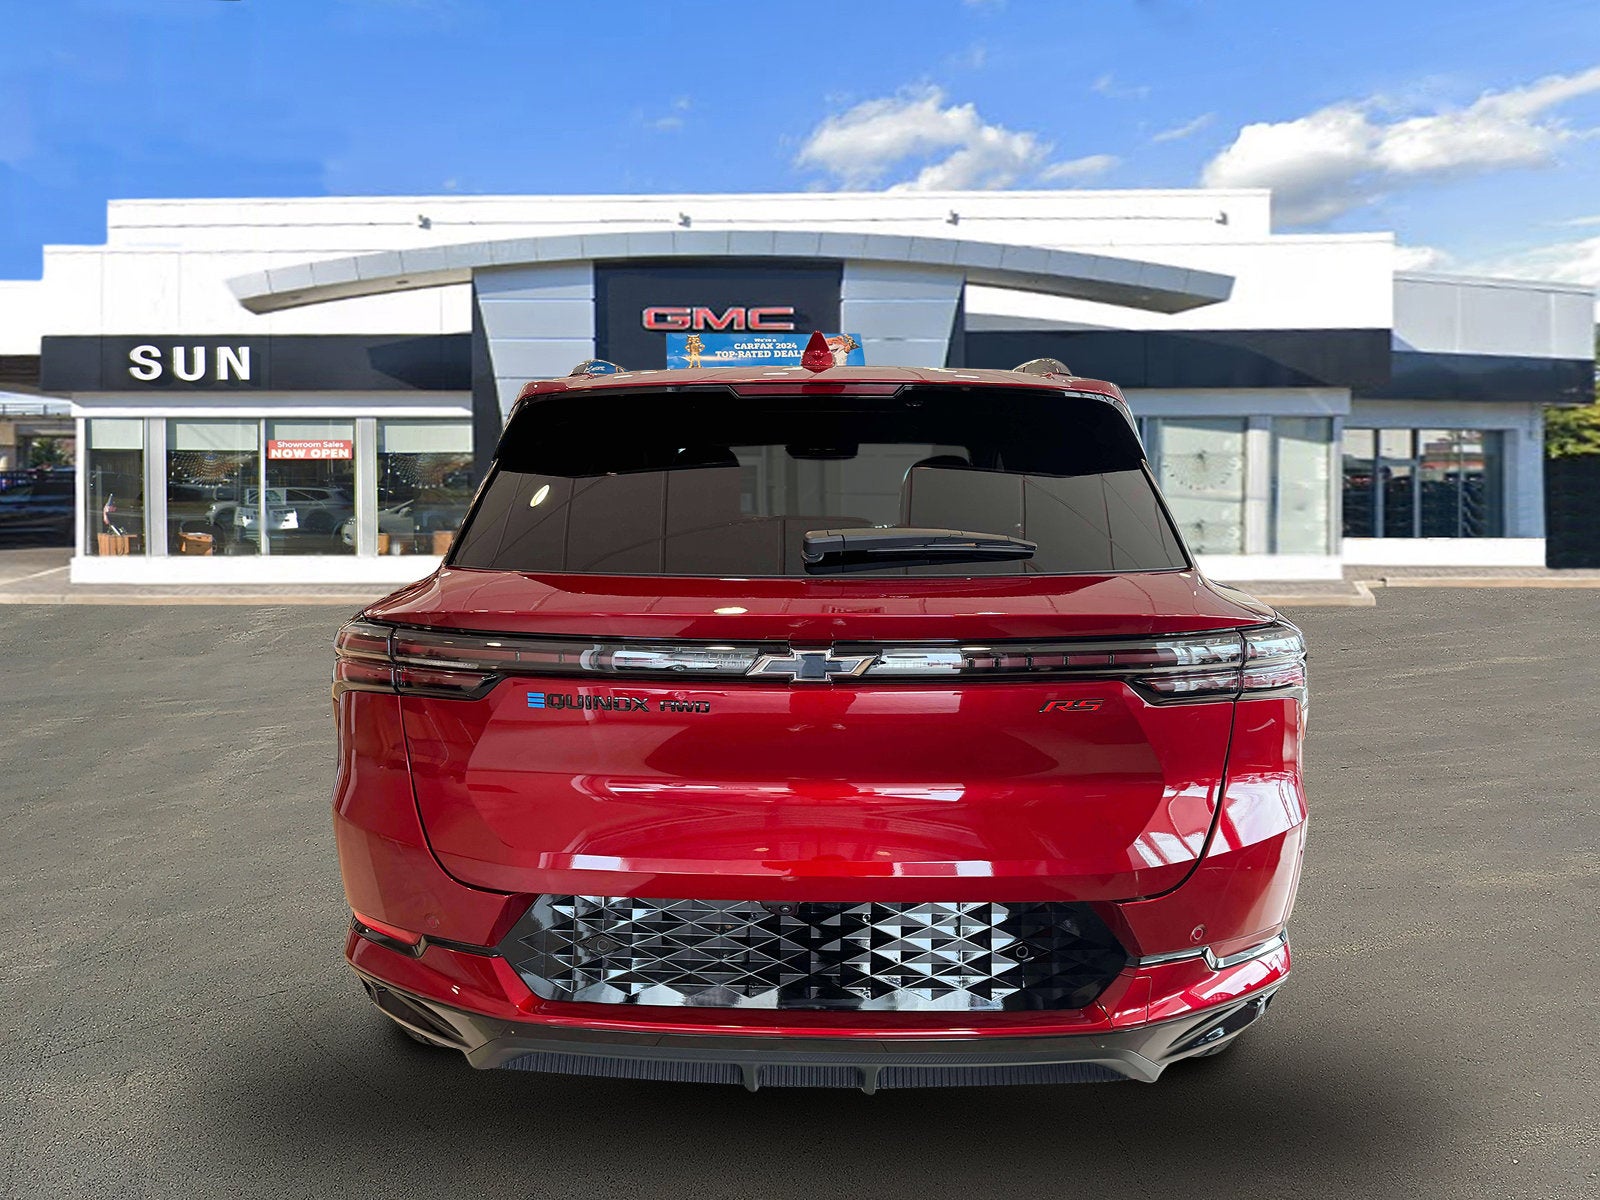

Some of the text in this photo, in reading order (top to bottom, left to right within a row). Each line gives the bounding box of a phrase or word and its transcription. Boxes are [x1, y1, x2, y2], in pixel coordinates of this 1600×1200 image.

[642, 307, 795, 330] GMC
[734, 342, 798, 350] CARFAX 2024
[715, 350, 772, 358] TOP-RATED
[128, 345, 250, 381] SUN
[271, 449, 349, 459] NOW OPEN
[527, 692, 711, 714] EQUINOX AWD
[1039, 698, 1105, 712] RS
